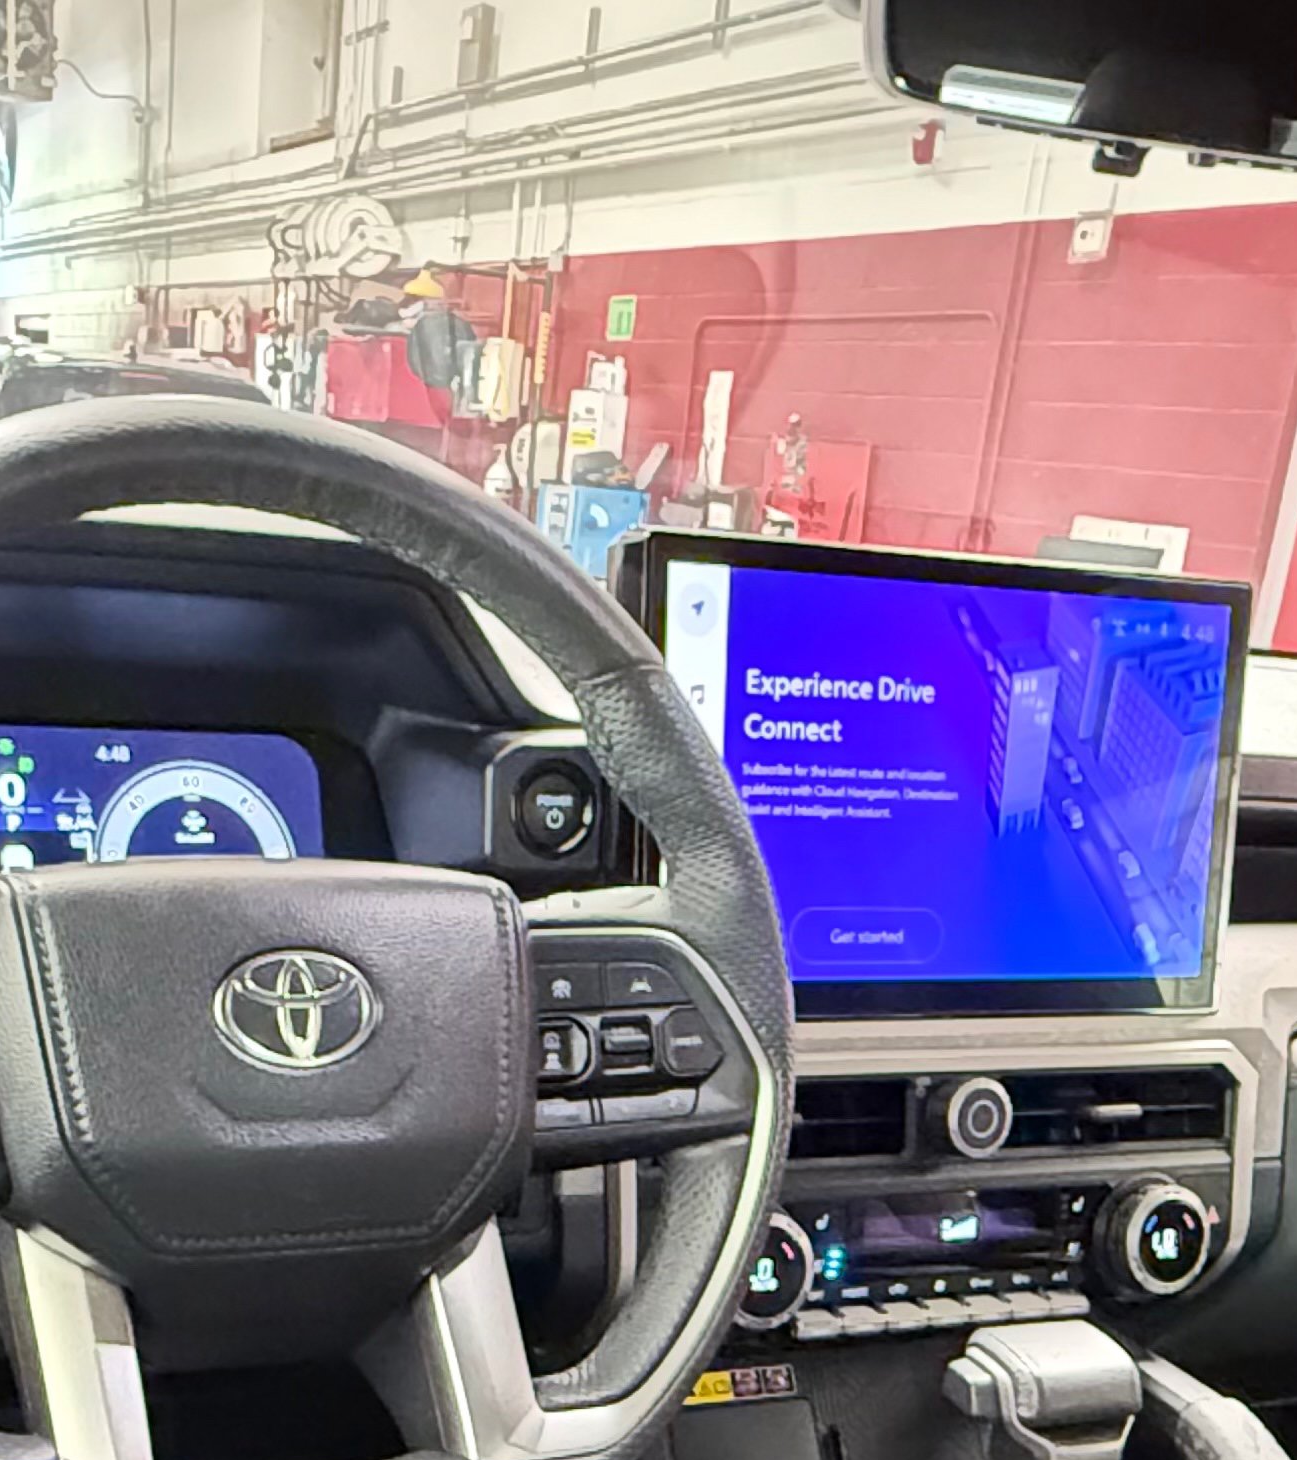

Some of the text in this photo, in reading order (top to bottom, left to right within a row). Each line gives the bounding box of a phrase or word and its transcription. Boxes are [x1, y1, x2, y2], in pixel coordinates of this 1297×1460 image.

[745, 668, 936, 704] Experience Drive
[743, 712, 843, 742] Connect
[813, 784, 846, 798] Cloud
[829, 927, 855, 944] Get
